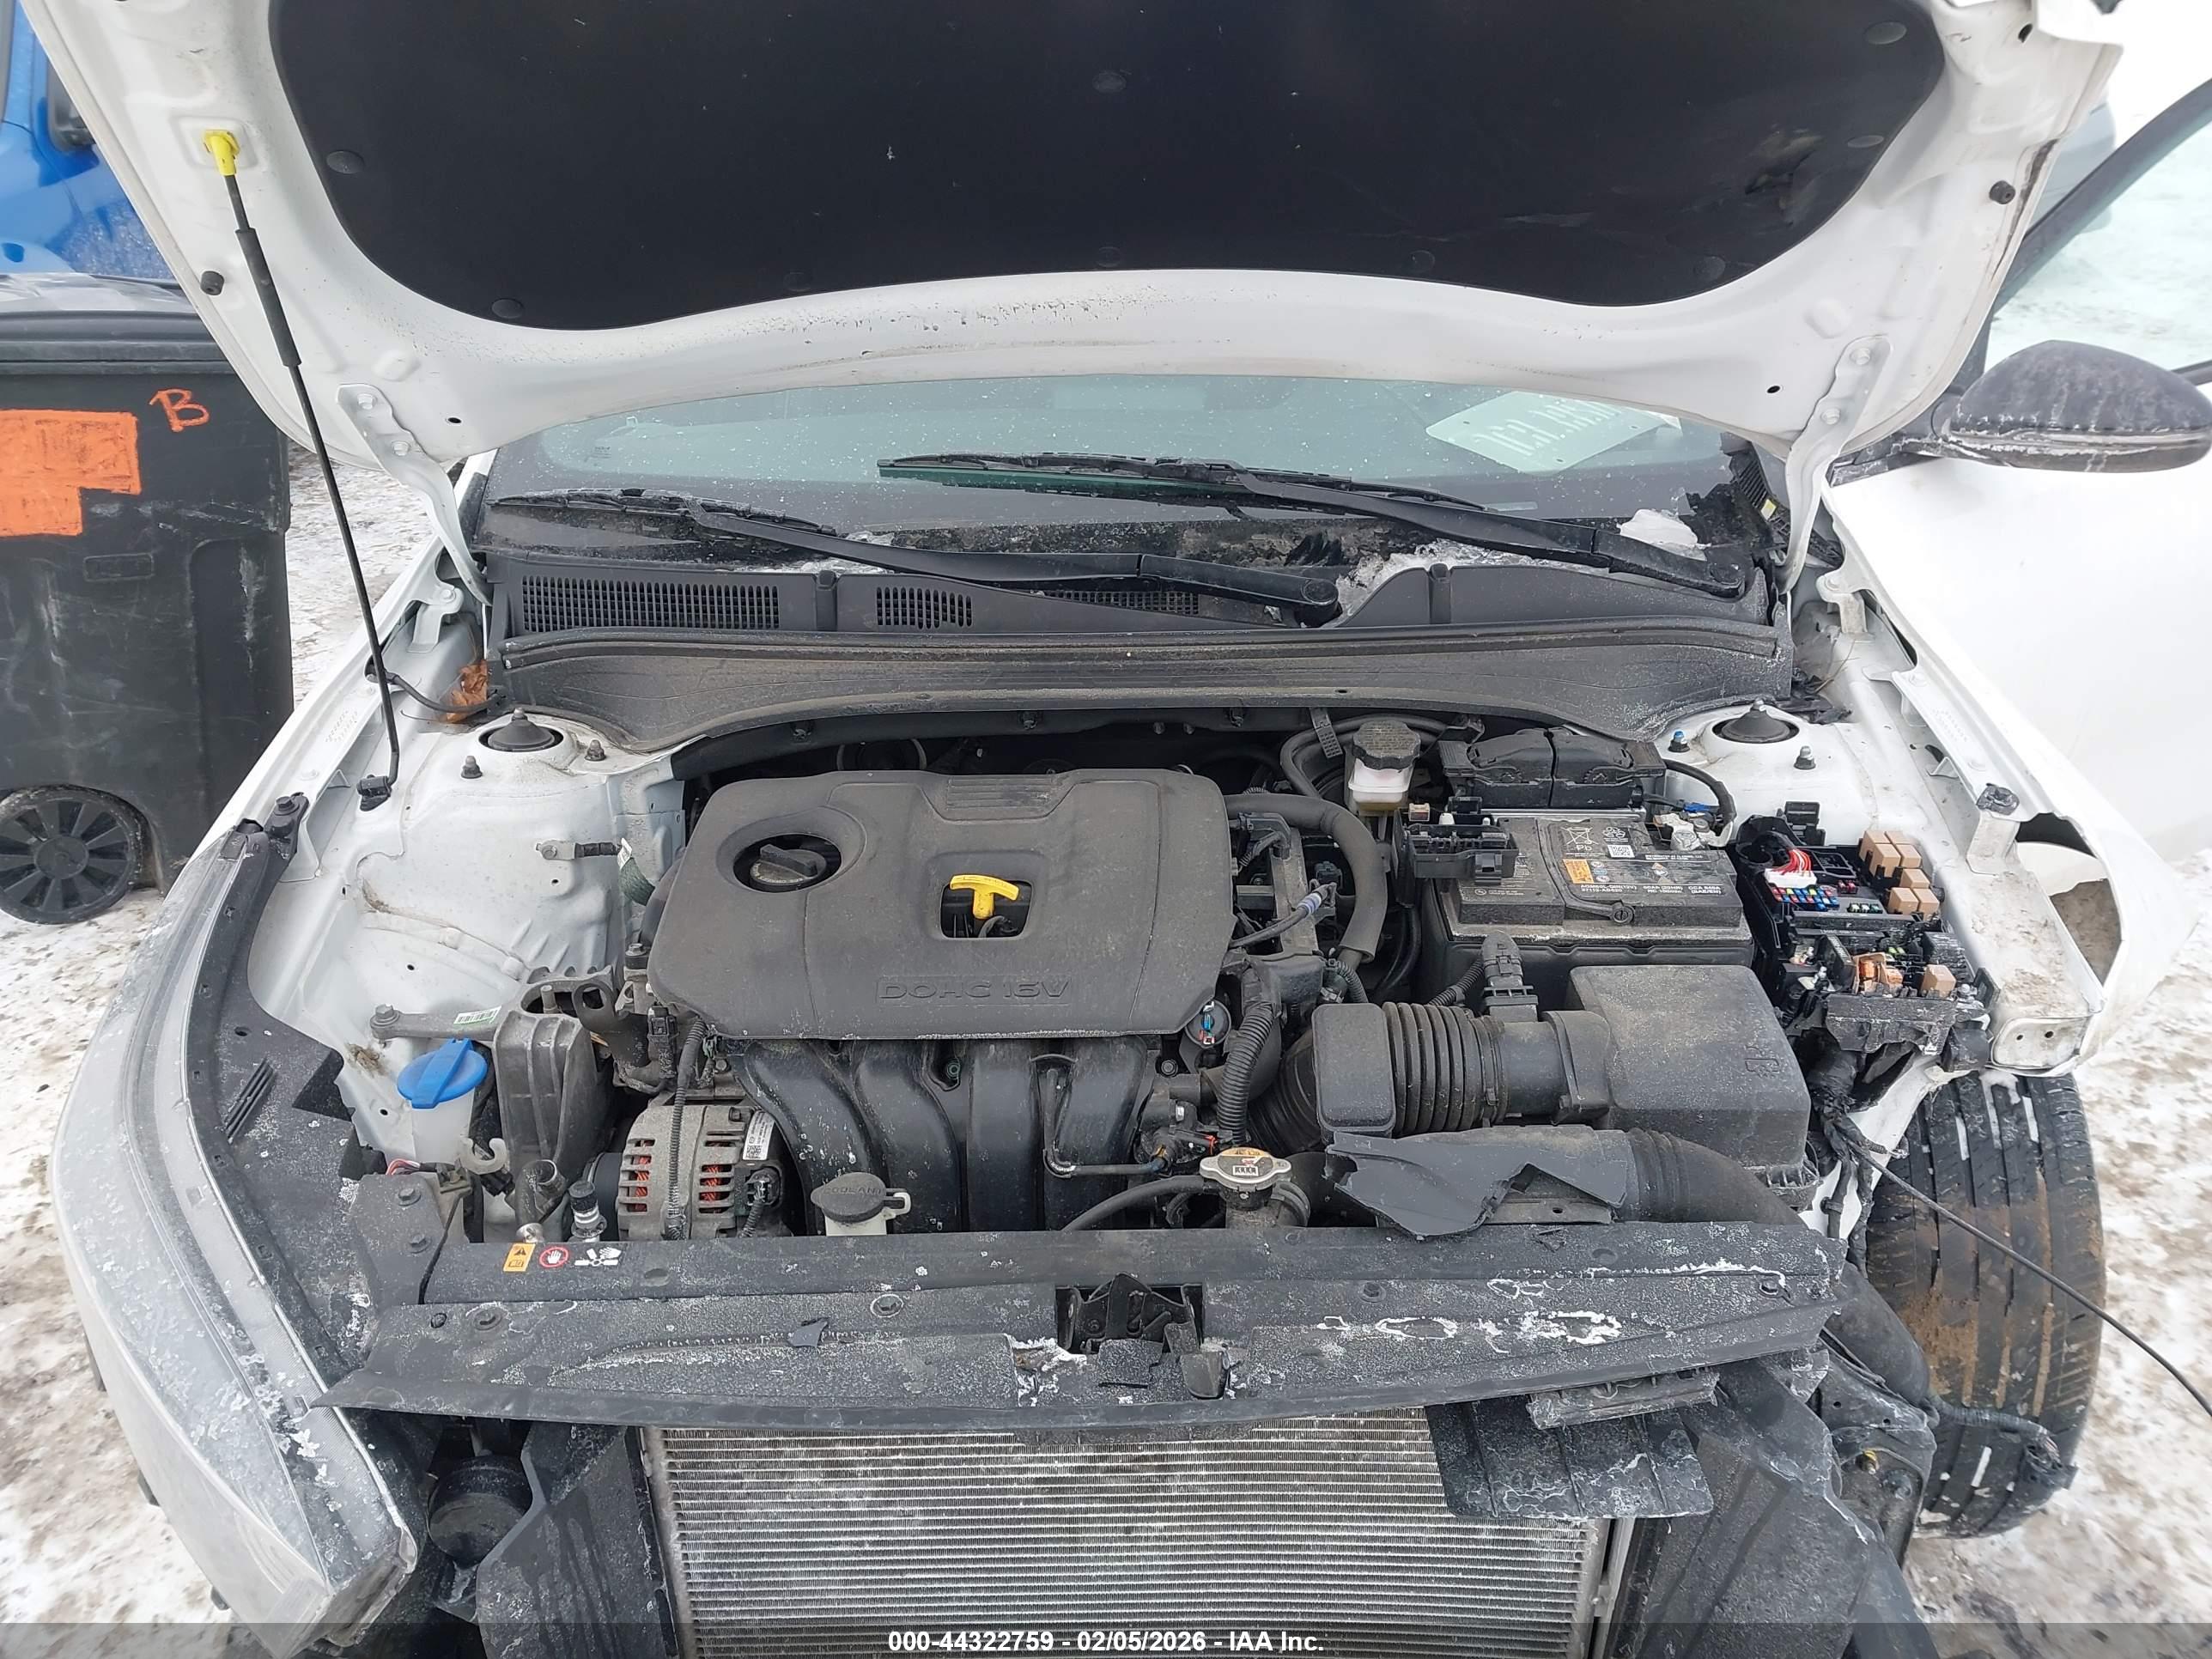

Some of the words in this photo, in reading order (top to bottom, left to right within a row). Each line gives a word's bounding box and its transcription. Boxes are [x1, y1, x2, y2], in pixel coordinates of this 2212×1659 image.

[149, 388, 210, 433] B
[1576, 844, 1593, 853] Pb
[878, 981, 991, 999] DOHC
[1003, 981, 1071, 999] 16V
